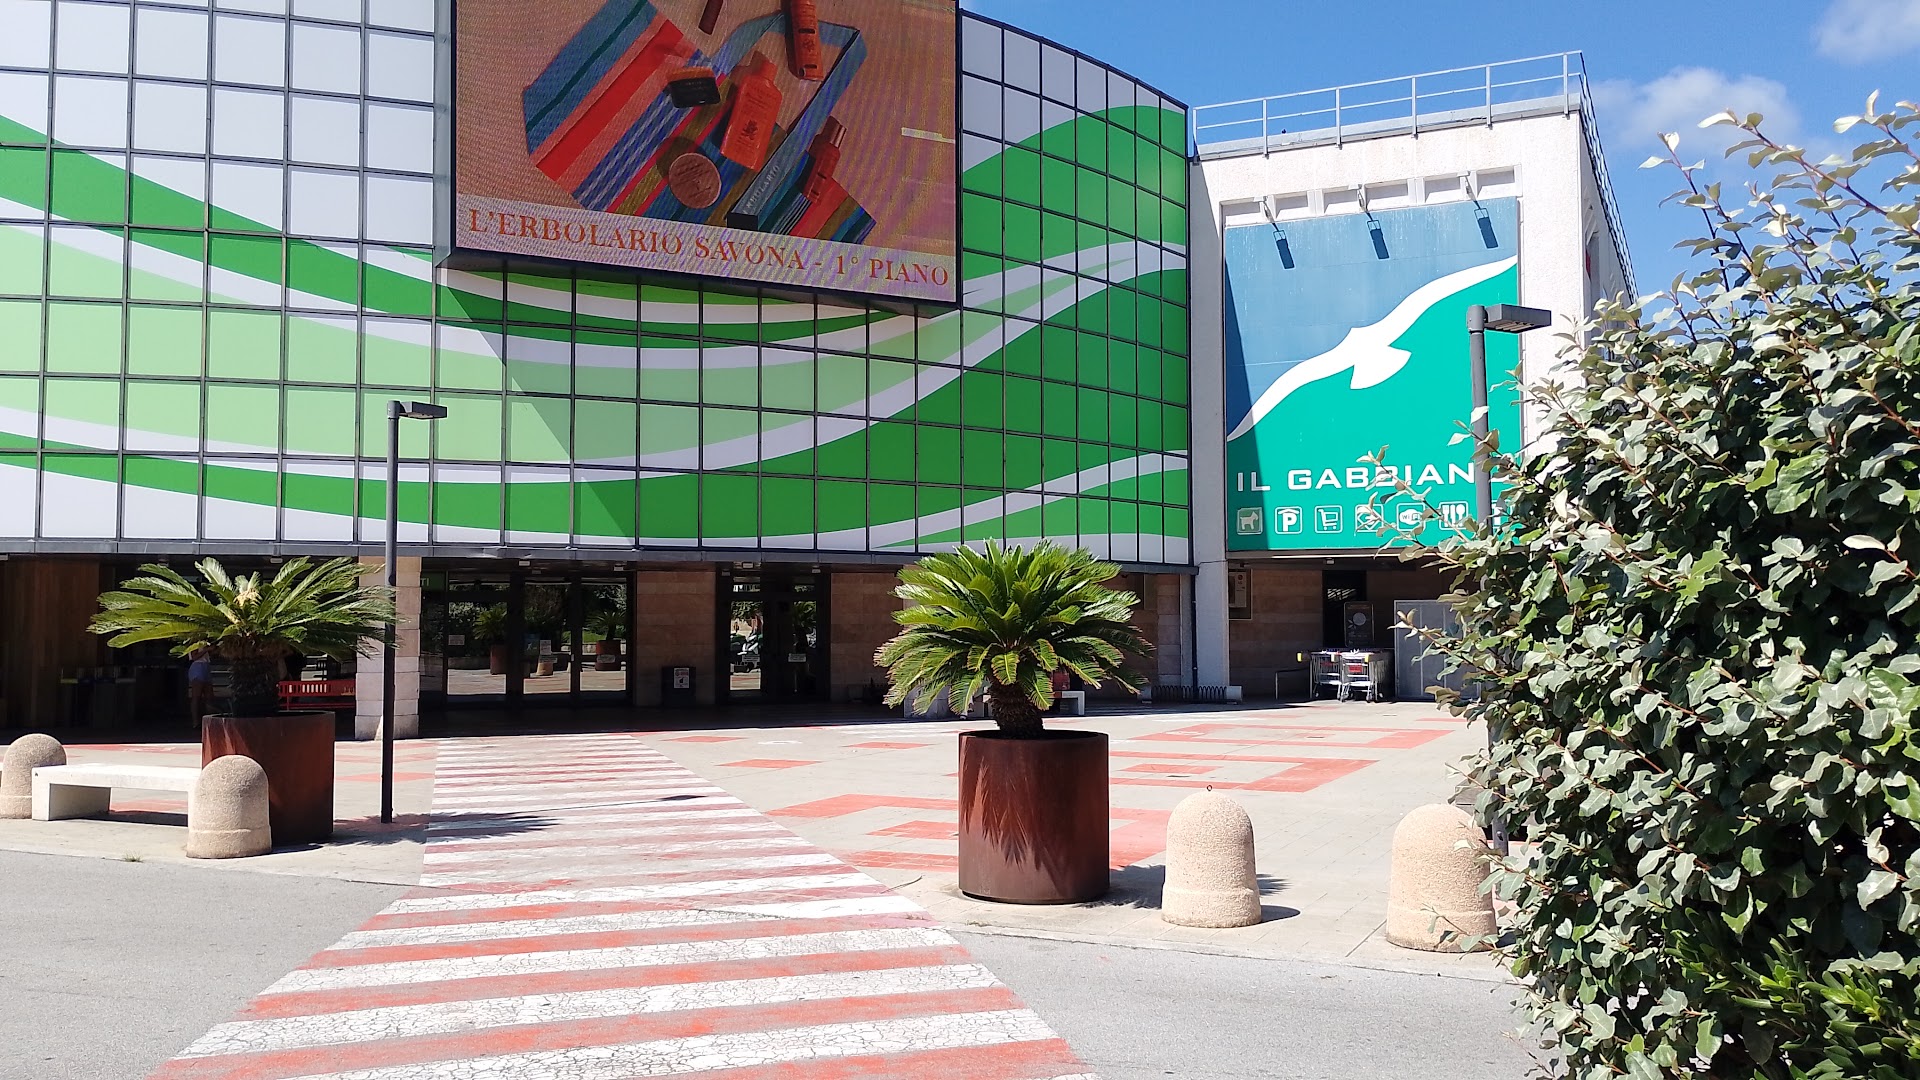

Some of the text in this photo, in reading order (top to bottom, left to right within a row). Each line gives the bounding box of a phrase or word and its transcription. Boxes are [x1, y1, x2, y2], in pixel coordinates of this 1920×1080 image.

[469, 208, 683, 255] L'ERBOLARIO
[695, 237, 804, 270] SAVONA
[836, 255, 859, 275] 1°
[869, 258, 949, 286] PIANO
[1237, 462, 1510, 492] IL GABBIAN
